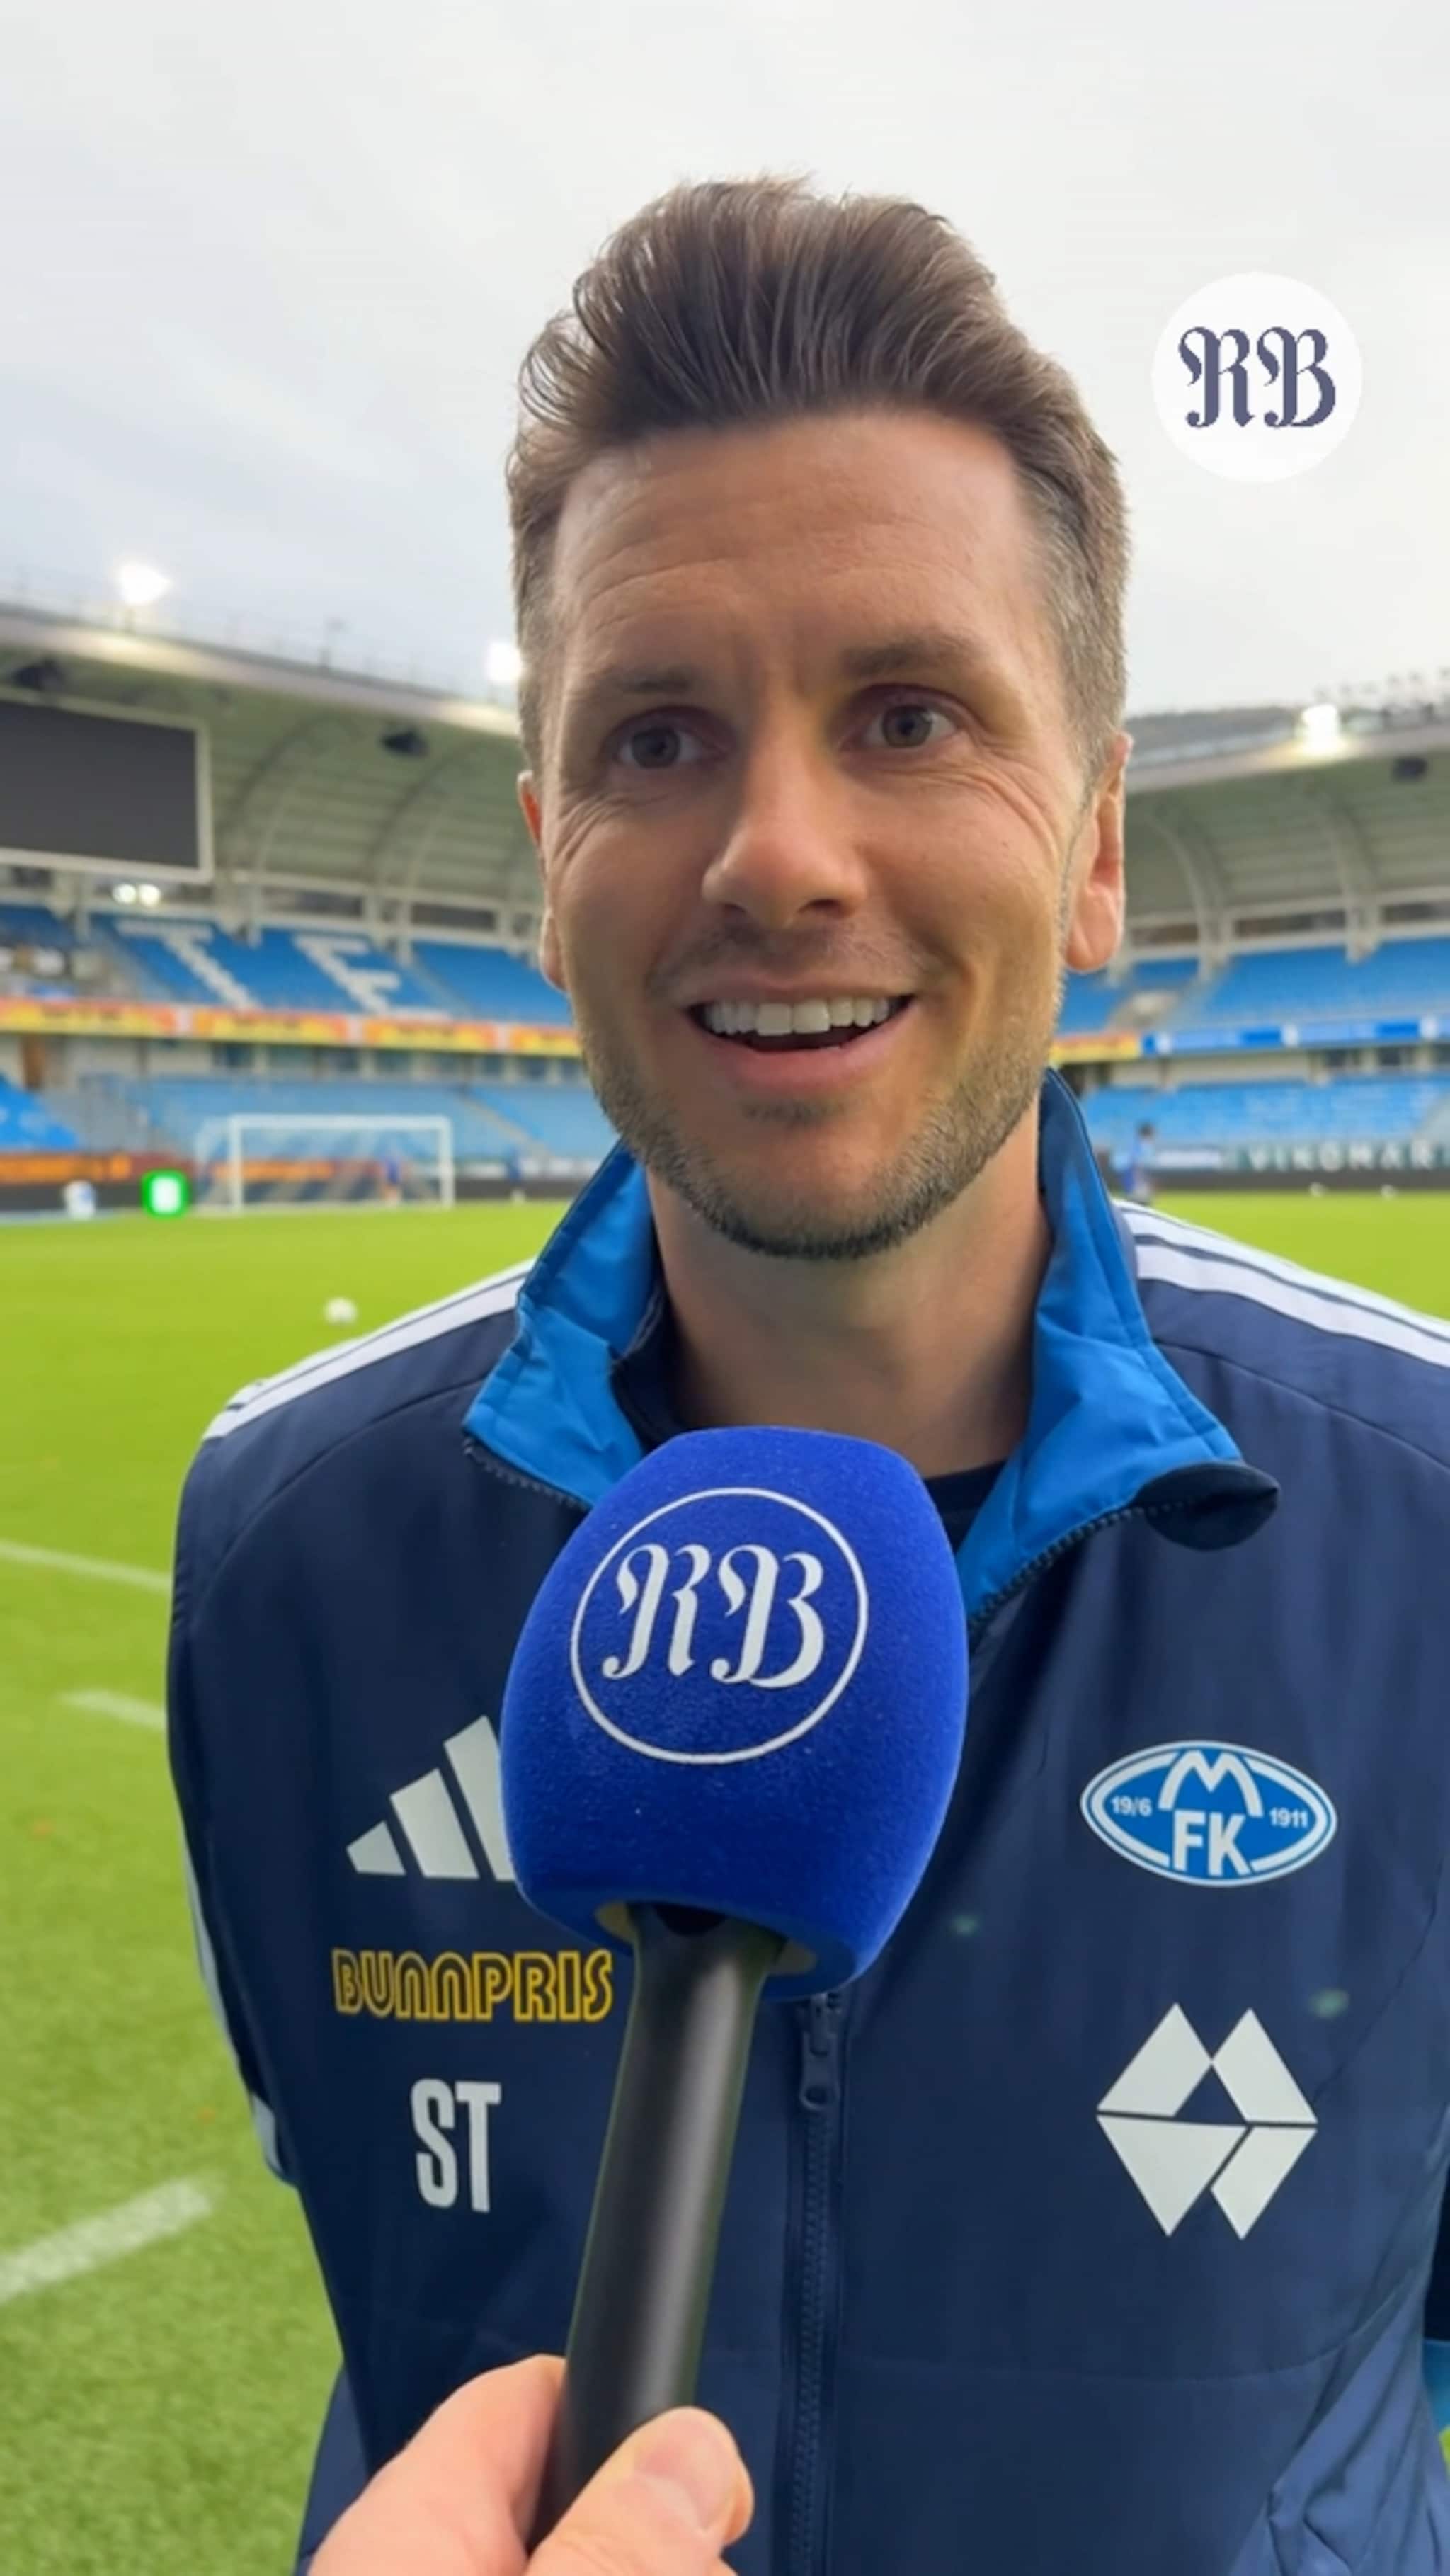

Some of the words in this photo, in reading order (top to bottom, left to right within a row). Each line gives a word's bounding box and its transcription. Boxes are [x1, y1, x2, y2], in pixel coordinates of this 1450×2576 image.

[602, 1544, 825, 1689] RB
[1111, 1795, 1153, 1817] 19/6
[1158, 1750, 1262, 1818] M
[1269, 1806, 1308, 1828] 1911
[1172, 1809, 1252, 1876] FK
[332, 1947, 613, 2023] BUNNPRIS
[410, 2078, 502, 2213] ST
